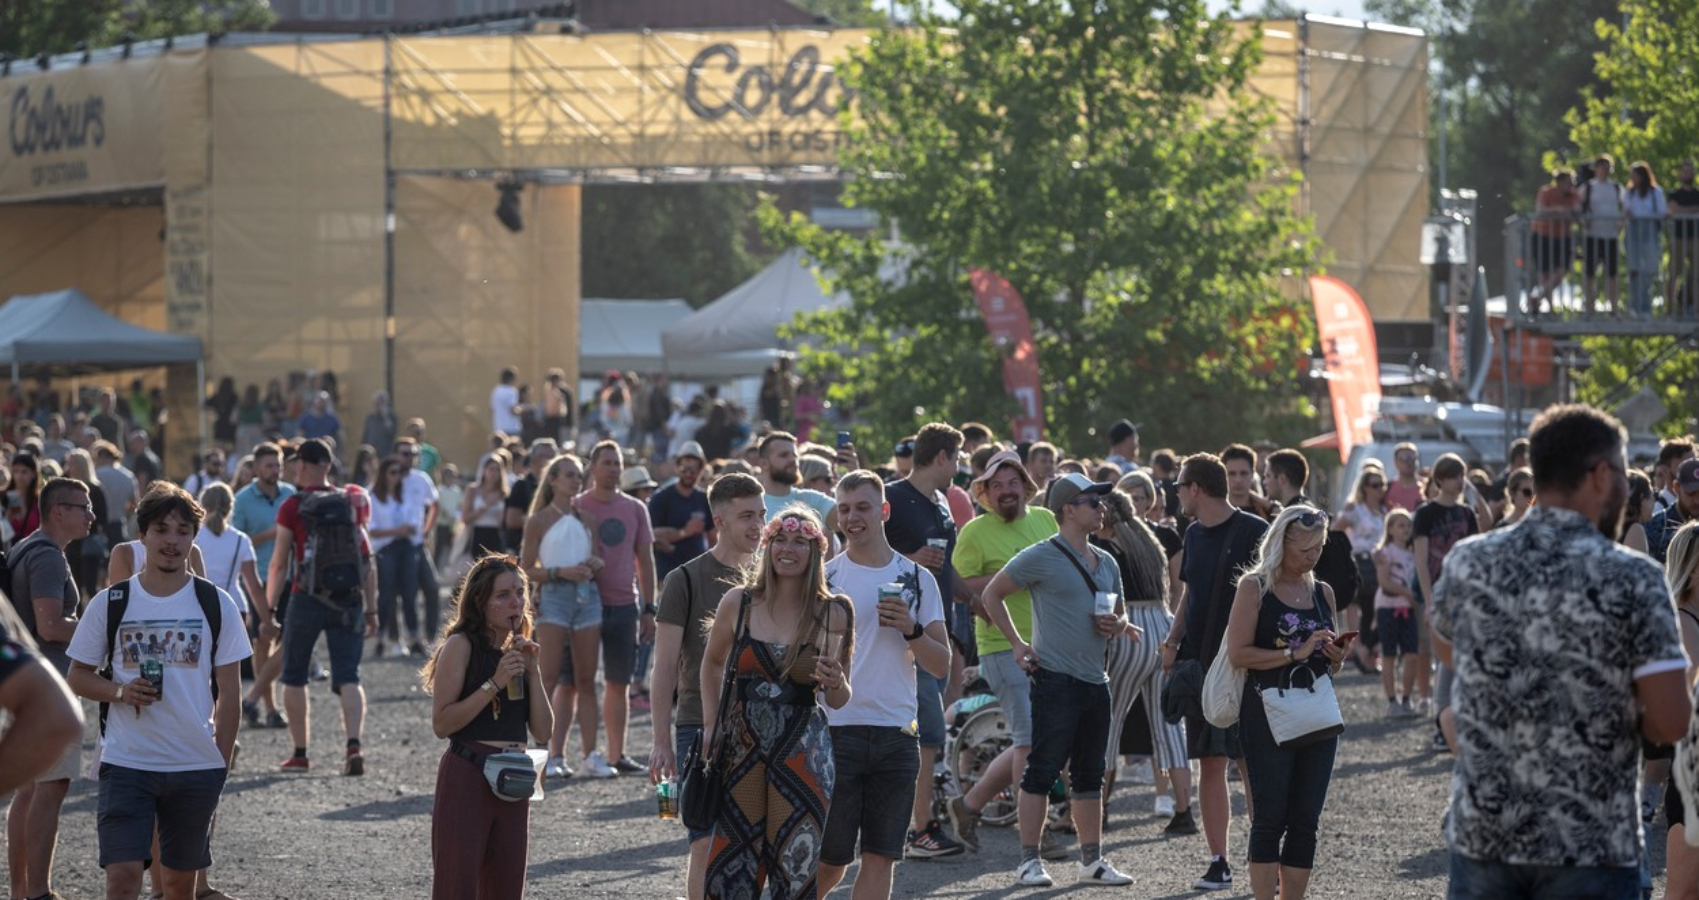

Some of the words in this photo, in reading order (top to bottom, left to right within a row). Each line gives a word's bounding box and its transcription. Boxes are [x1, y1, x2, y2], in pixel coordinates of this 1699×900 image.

[685, 43, 854, 119] Colo
[9, 84, 105, 157] Colours
[745, 130, 781, 151] OF
